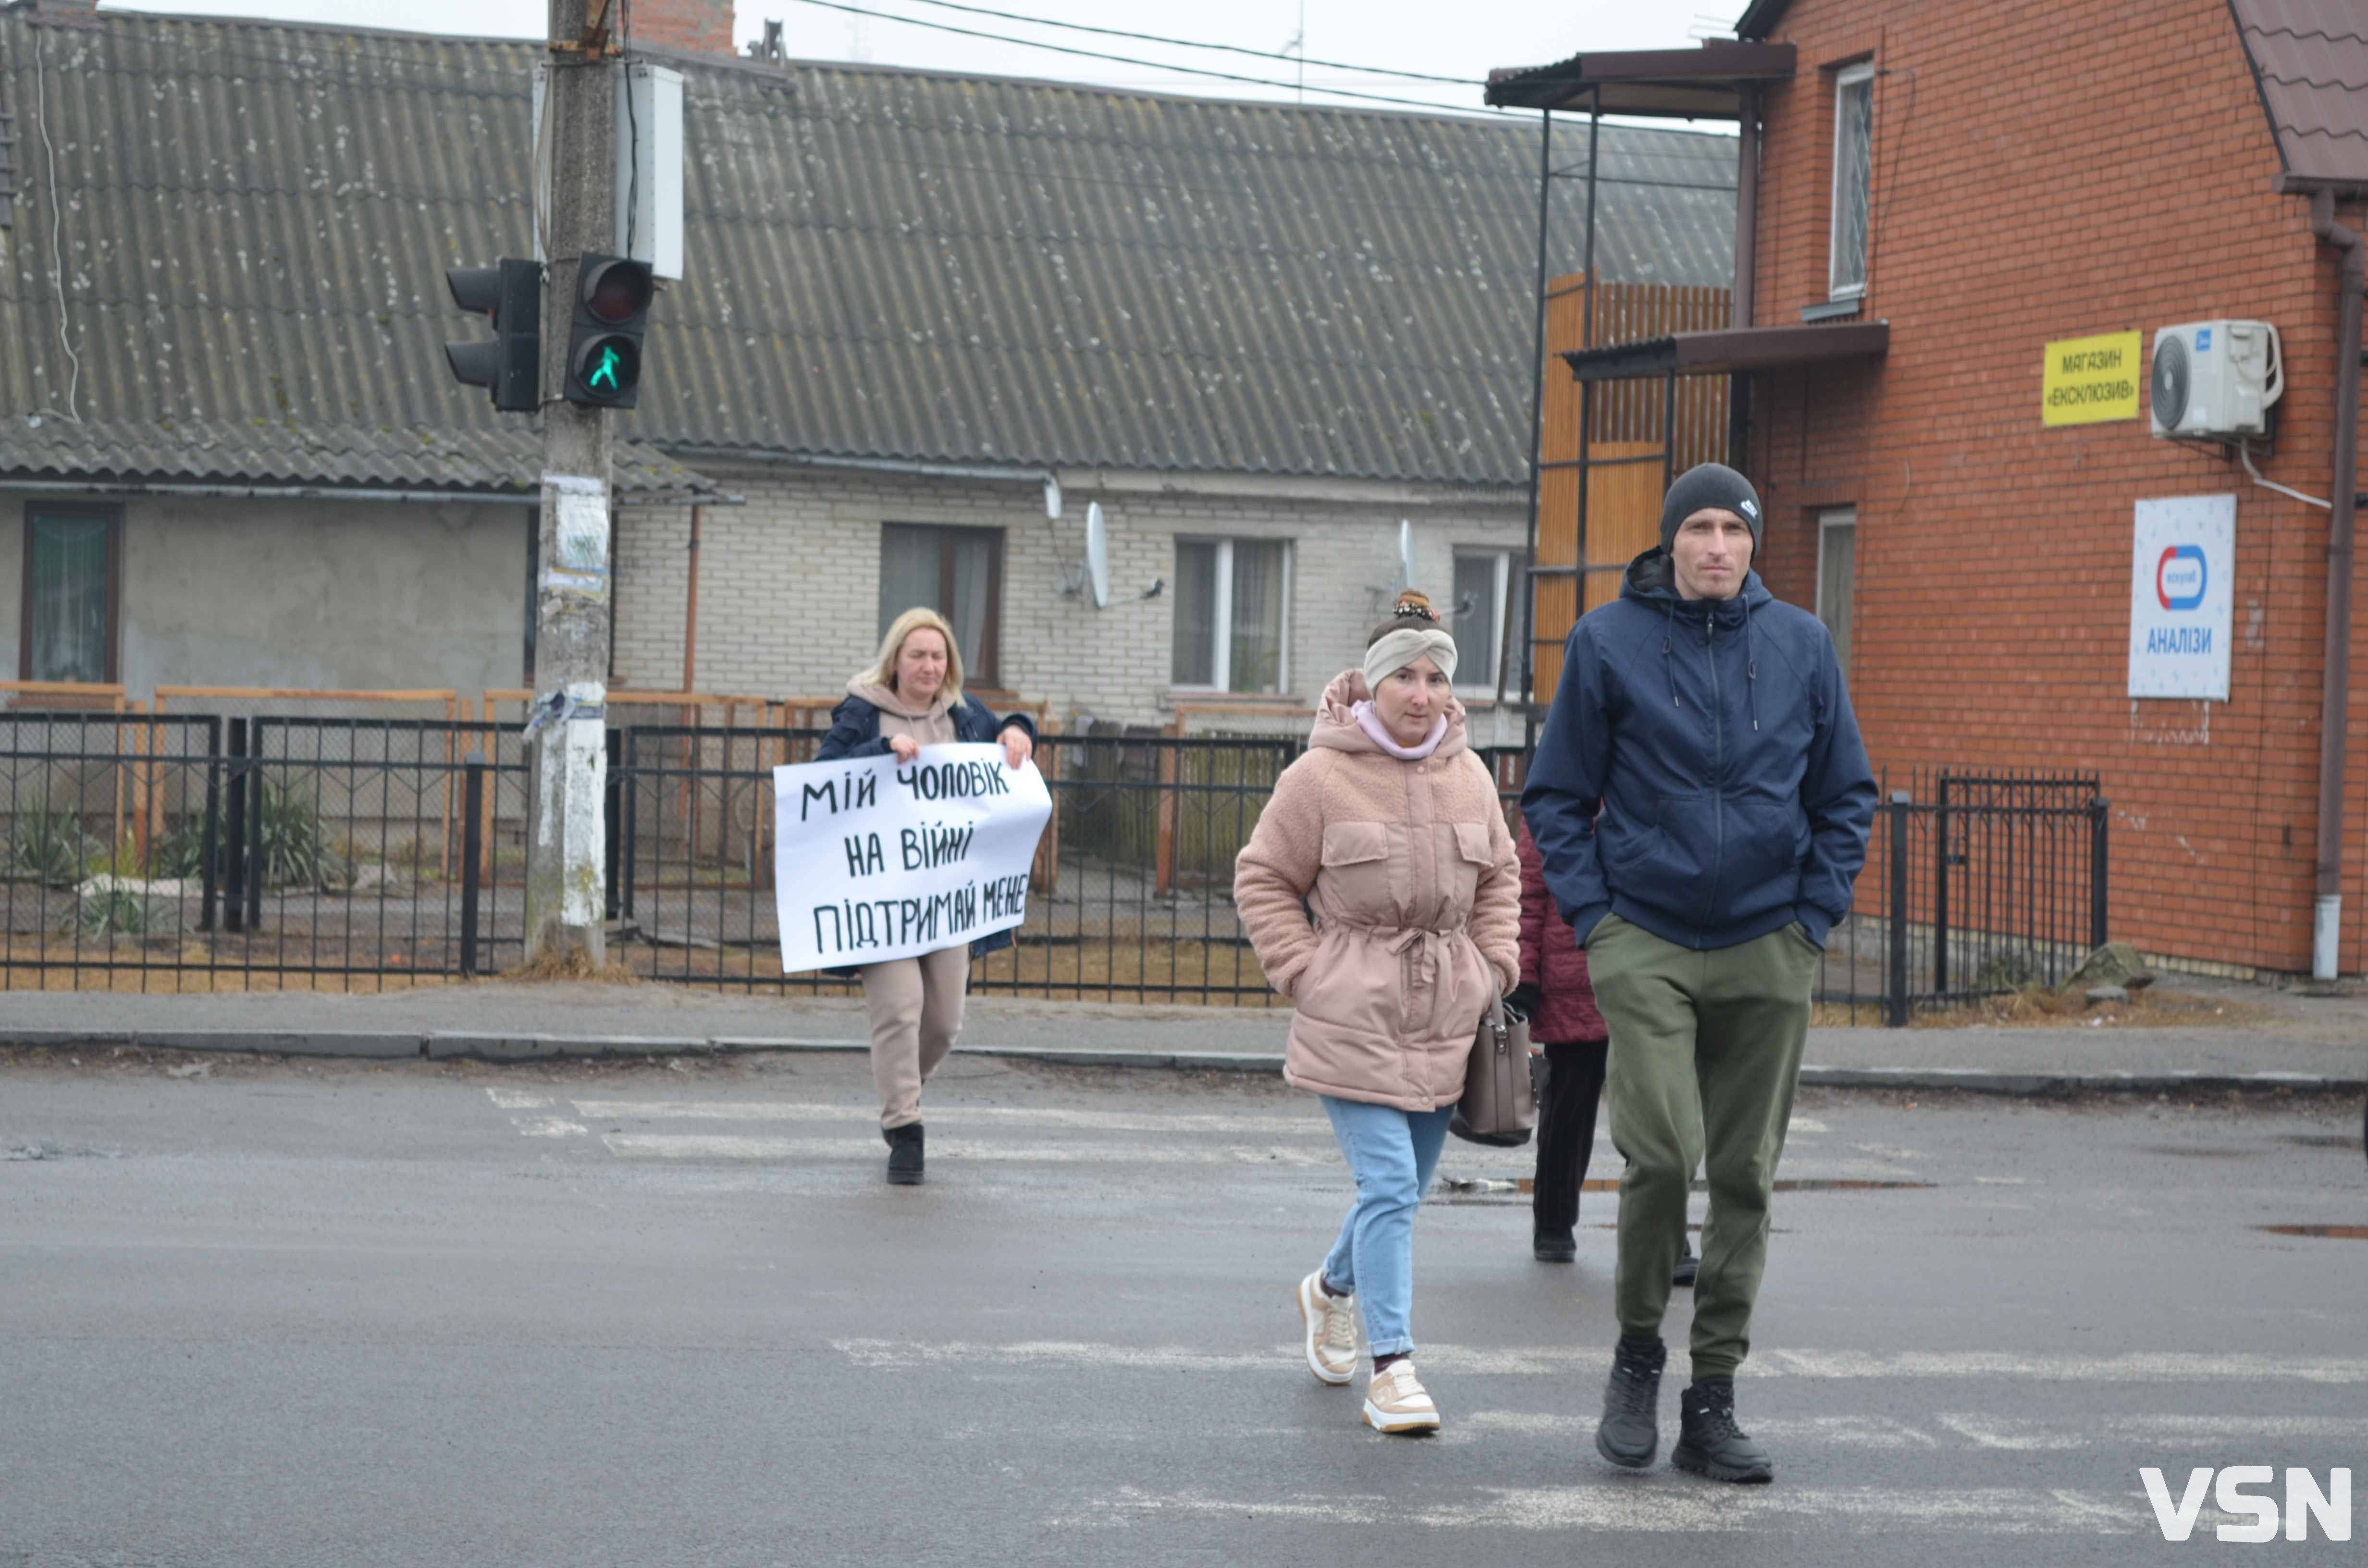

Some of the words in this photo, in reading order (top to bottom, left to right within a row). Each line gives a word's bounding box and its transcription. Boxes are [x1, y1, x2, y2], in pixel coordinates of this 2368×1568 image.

[2062, 349, 2122, 374] МАГАЗИН
[2047, 380, 2134, 406] «ЕКСКЛЮЗИВ»
[2147, 628, 2212, 654] АНАЛІЗИ
[897, 758, 1010, 801] ЧОЛОВІК
[844, 832, 885, 877] НА
[813, 880, 976, 954] ПІДТРИМАЙ
[983, 873, 1028, 924] МЕНЕ
